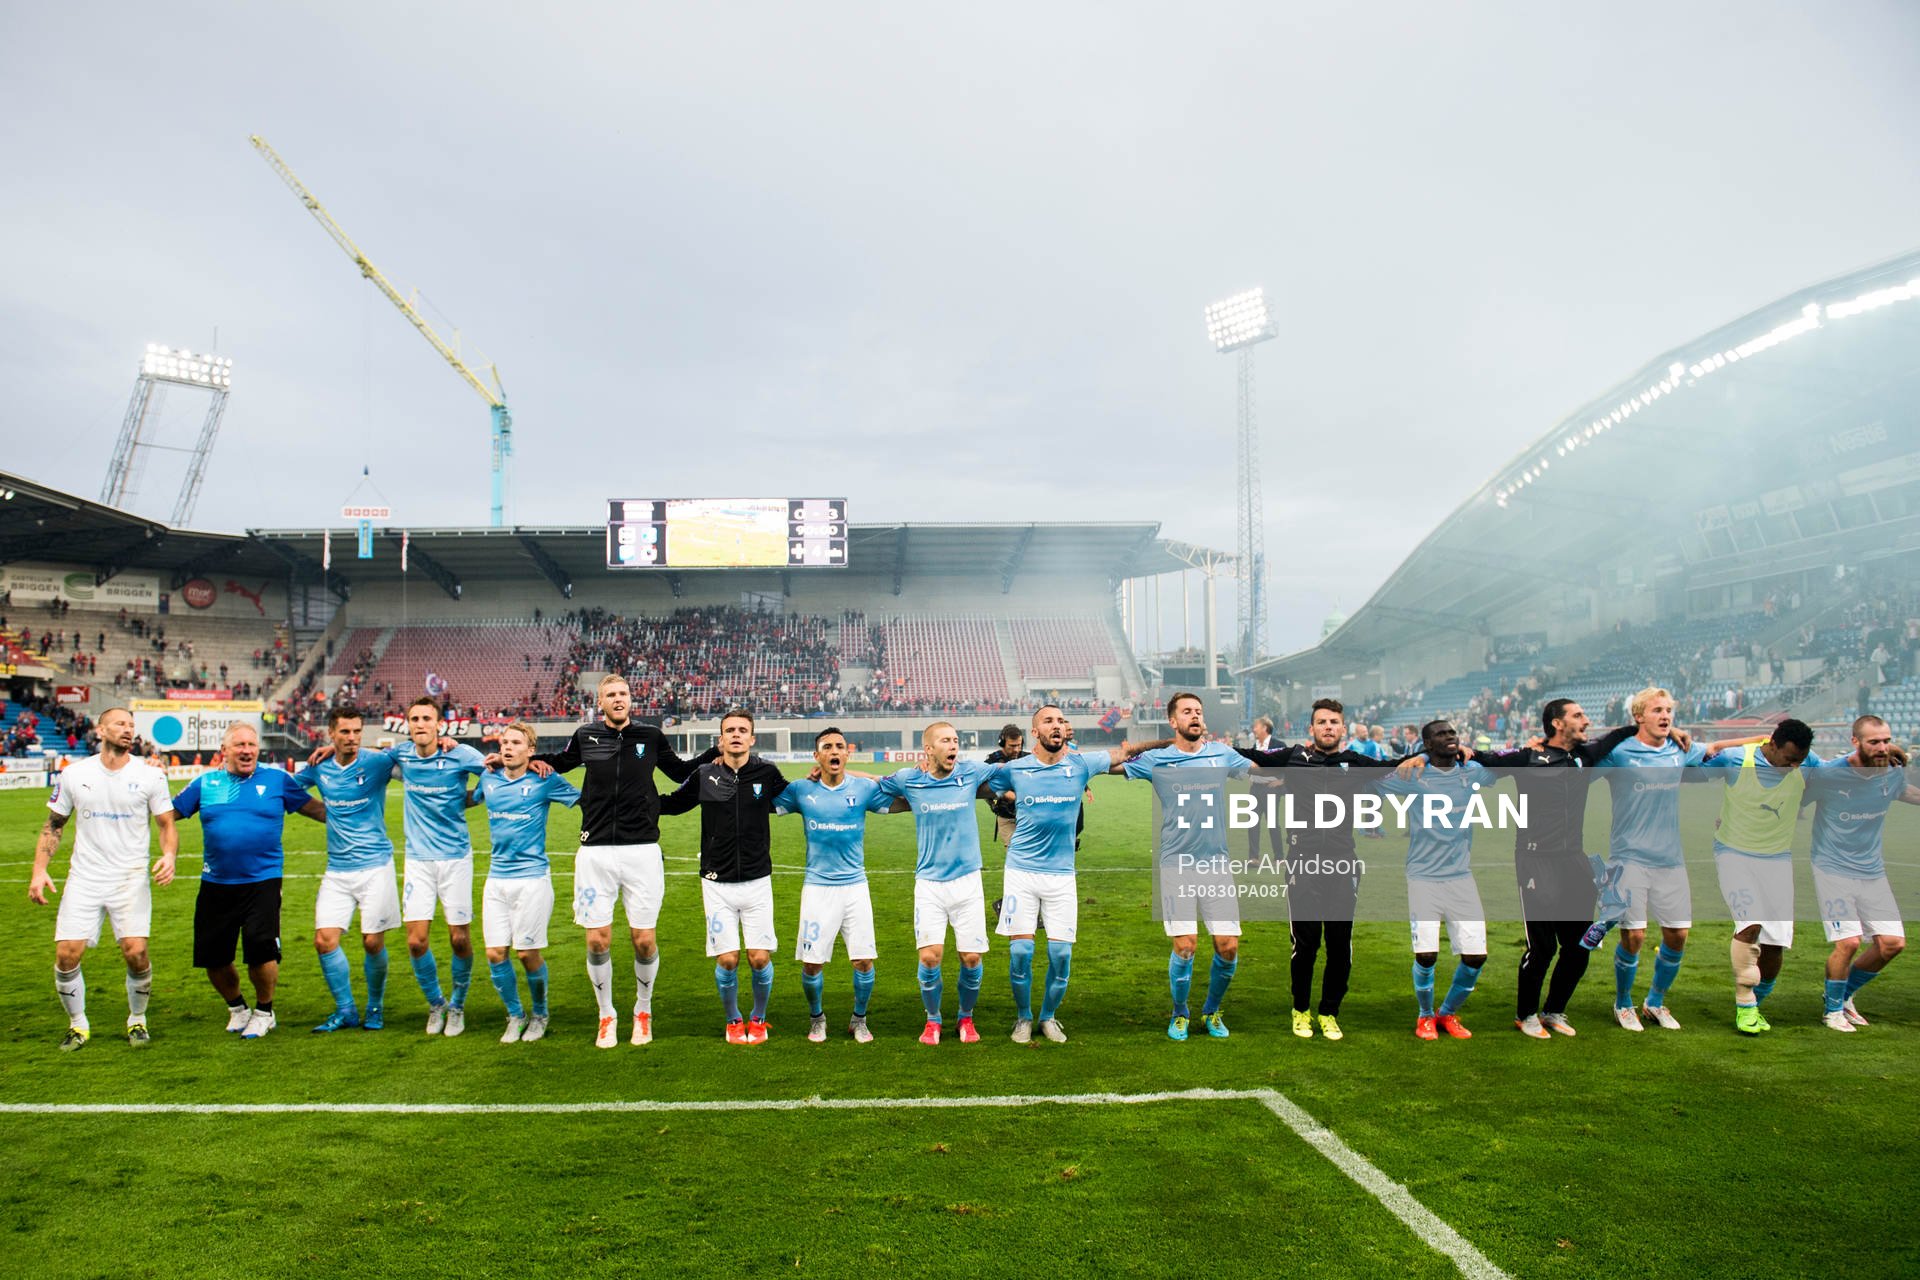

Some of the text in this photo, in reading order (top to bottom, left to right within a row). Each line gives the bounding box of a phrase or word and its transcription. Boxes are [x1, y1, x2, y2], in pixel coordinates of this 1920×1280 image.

[10, 582, 60, 593] BRIGGEN
[106, 588, 152, 598] BRIGGEN
[187, 716, 237, 730] Resur
[383, 717, 470, 737] STA 985
[895, 752, 927, 763] CRA
[704, 871, 718, 880] 26
[1527, 877, 1536, 890] A
[1825, 898, 1848, 918] 23
[803, 920, 821, 942] 13
